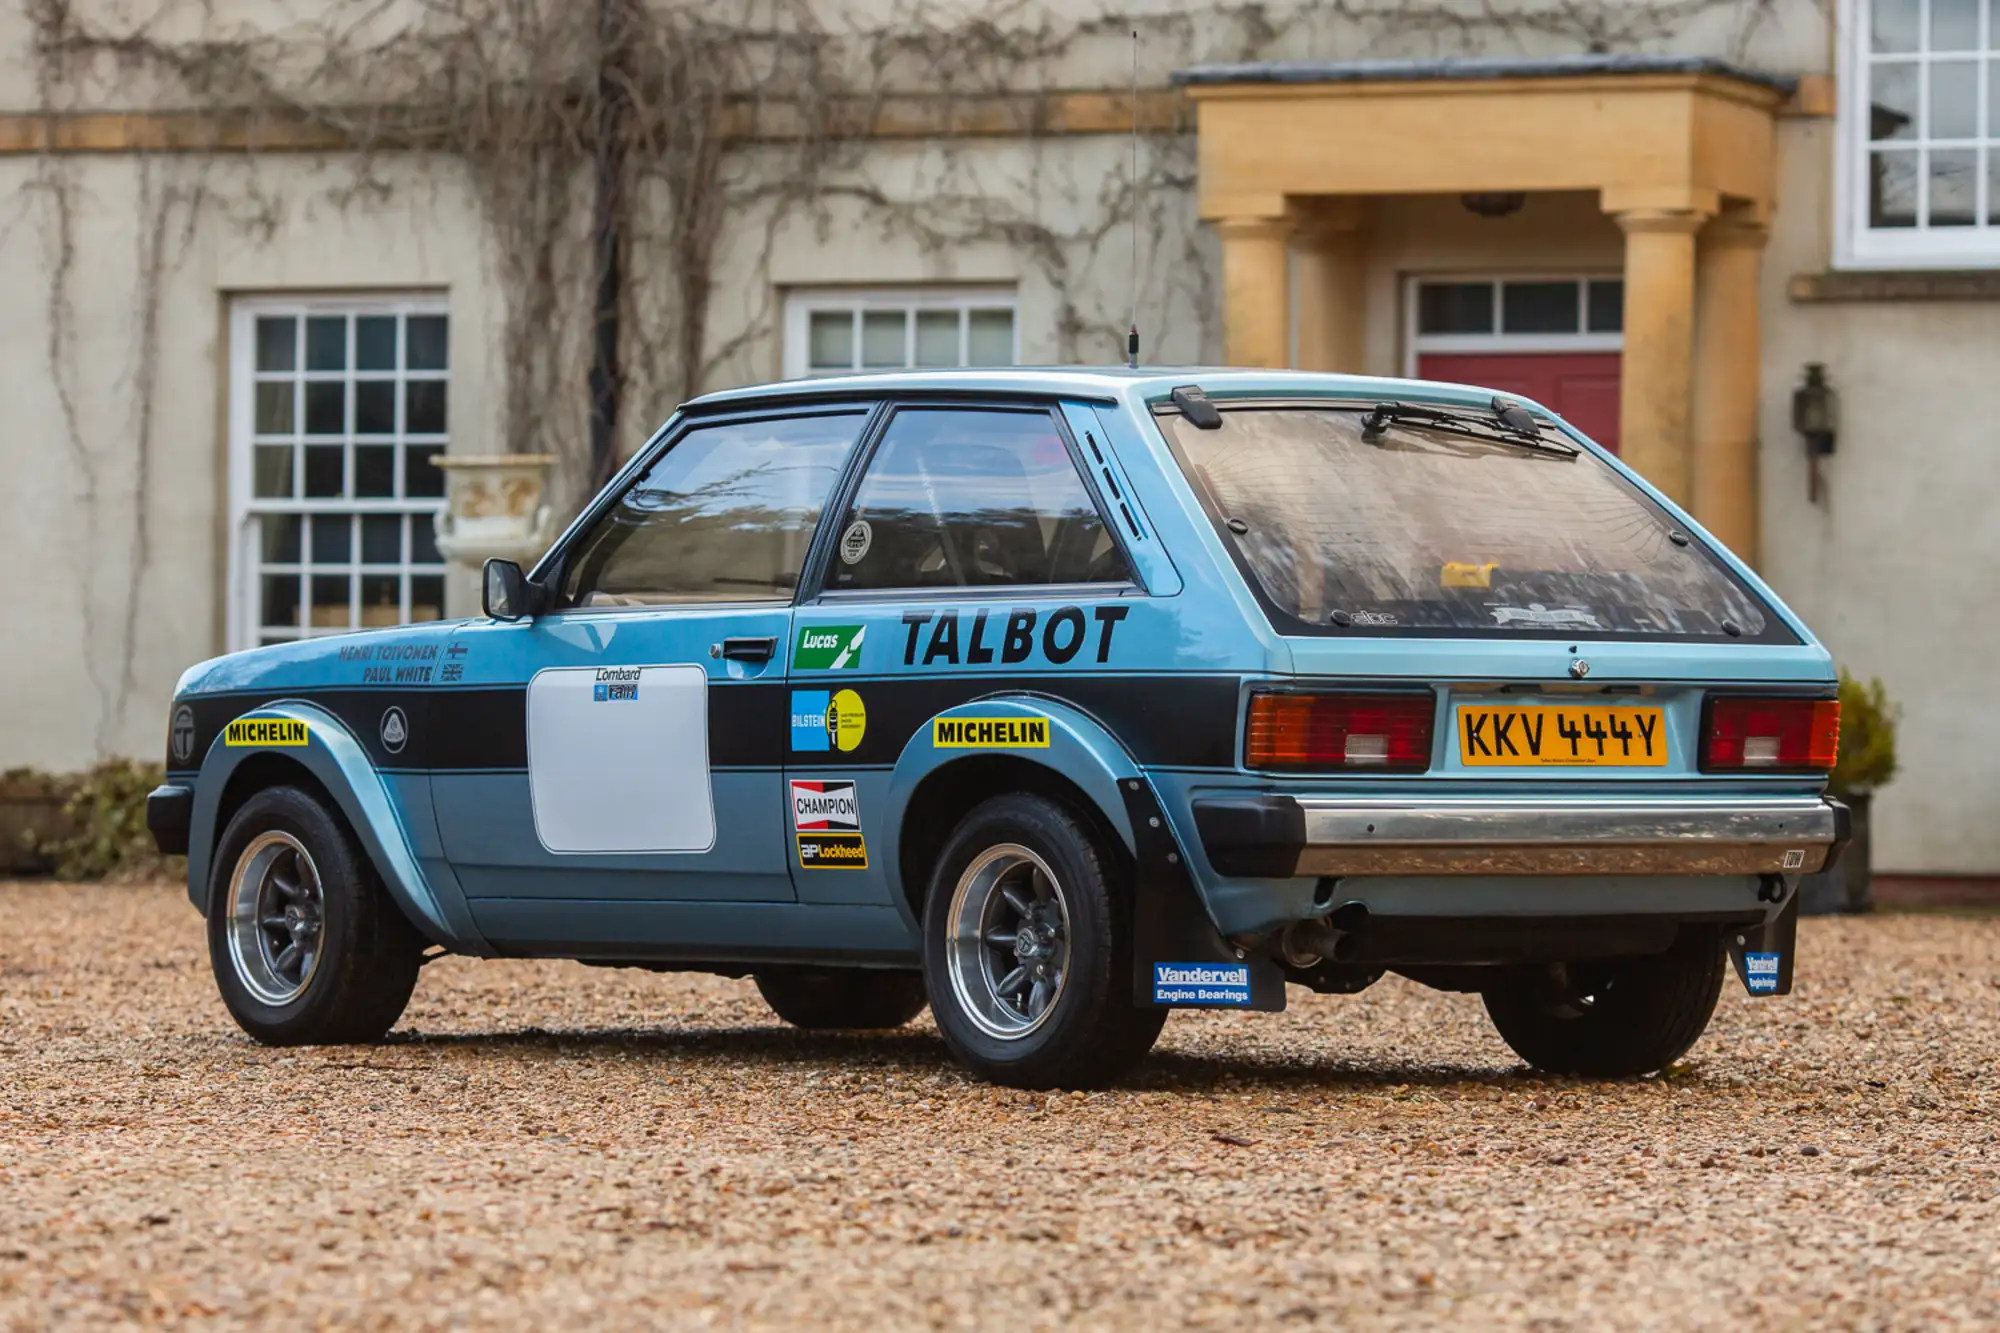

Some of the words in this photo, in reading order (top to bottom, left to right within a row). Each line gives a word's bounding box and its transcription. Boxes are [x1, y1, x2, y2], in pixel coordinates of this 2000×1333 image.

[802, 630, 839, 649] Lucas
[901, 605, 1130, 665] TALBOT
[338, 645, 374, 661] HENRI
[376, 644, 438, 661] TOIVONEN
[363, 666, 392, 682] PAUL
[395, 666, 433, 682] WHITE
[595, 667, 642, 681] Lombard
[792, 714, 826, 728] BILSTEIN
[229, 723, 304, 741] MICHELIN
[938, 722, 1044, 743] MICHELIN
[1465, 713, 1544, 756] KKV
[1557, 713, 1657, 757] 444Y
[796, 798, 855, 815] CHAMPION
[818, 843, 865, 858] Lockheed
[1158, 967, 1247, 982] Vandervell
[1157, 989, 1196, 1001] Engine
[1198, 989, 1248, 1002] Bearings
